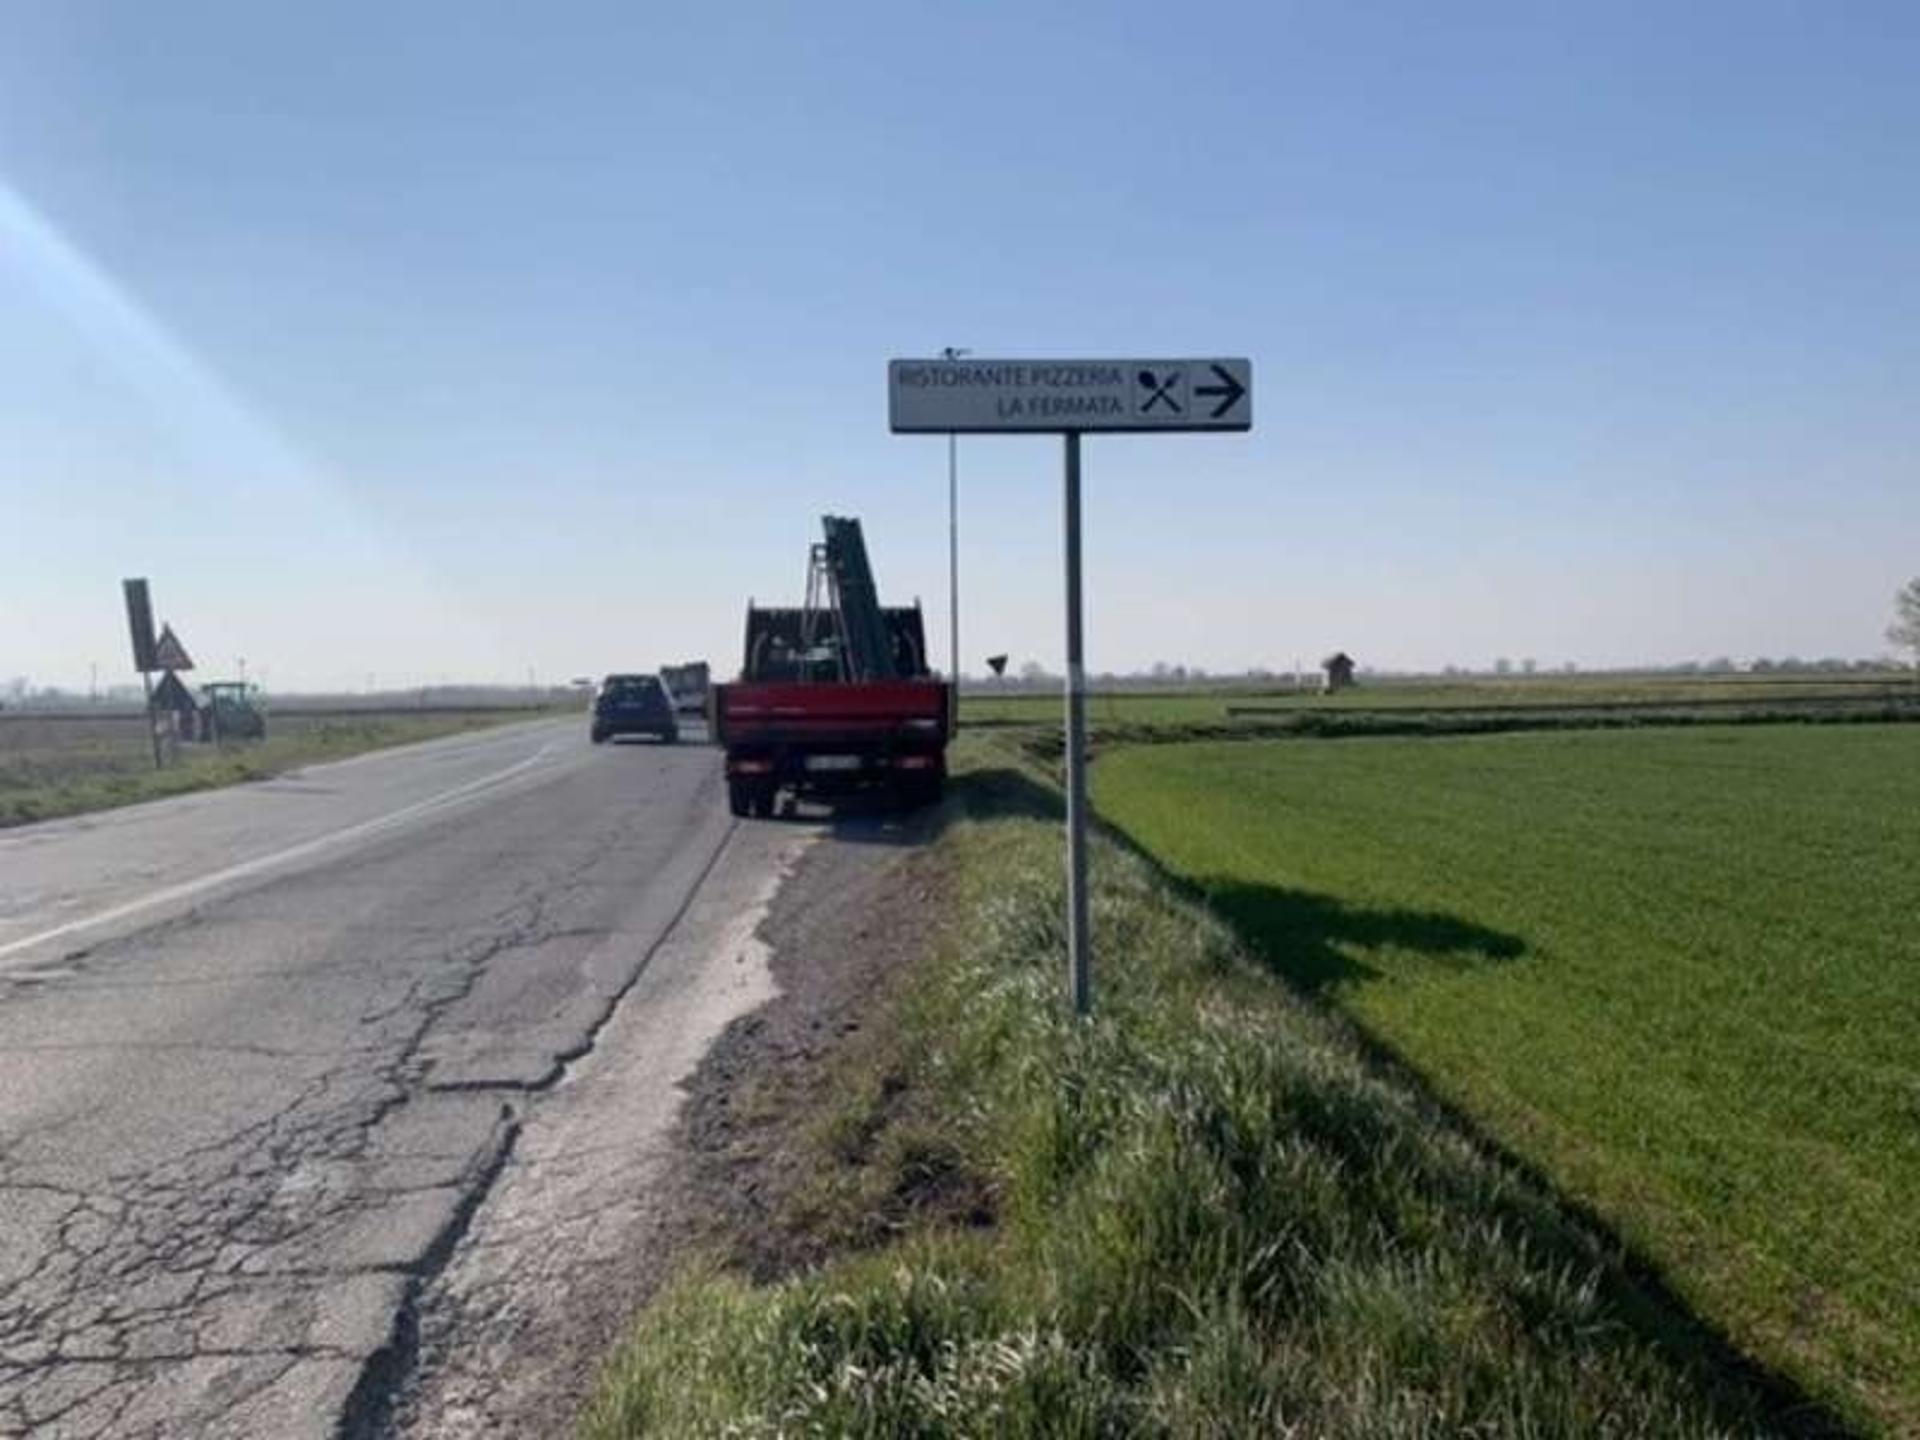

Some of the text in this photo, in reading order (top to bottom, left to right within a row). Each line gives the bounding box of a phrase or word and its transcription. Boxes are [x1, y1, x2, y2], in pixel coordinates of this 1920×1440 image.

[1030, 365, 1123, 387] PIZZERIA
[997, 395, 1123, 418] LA FERMATA
